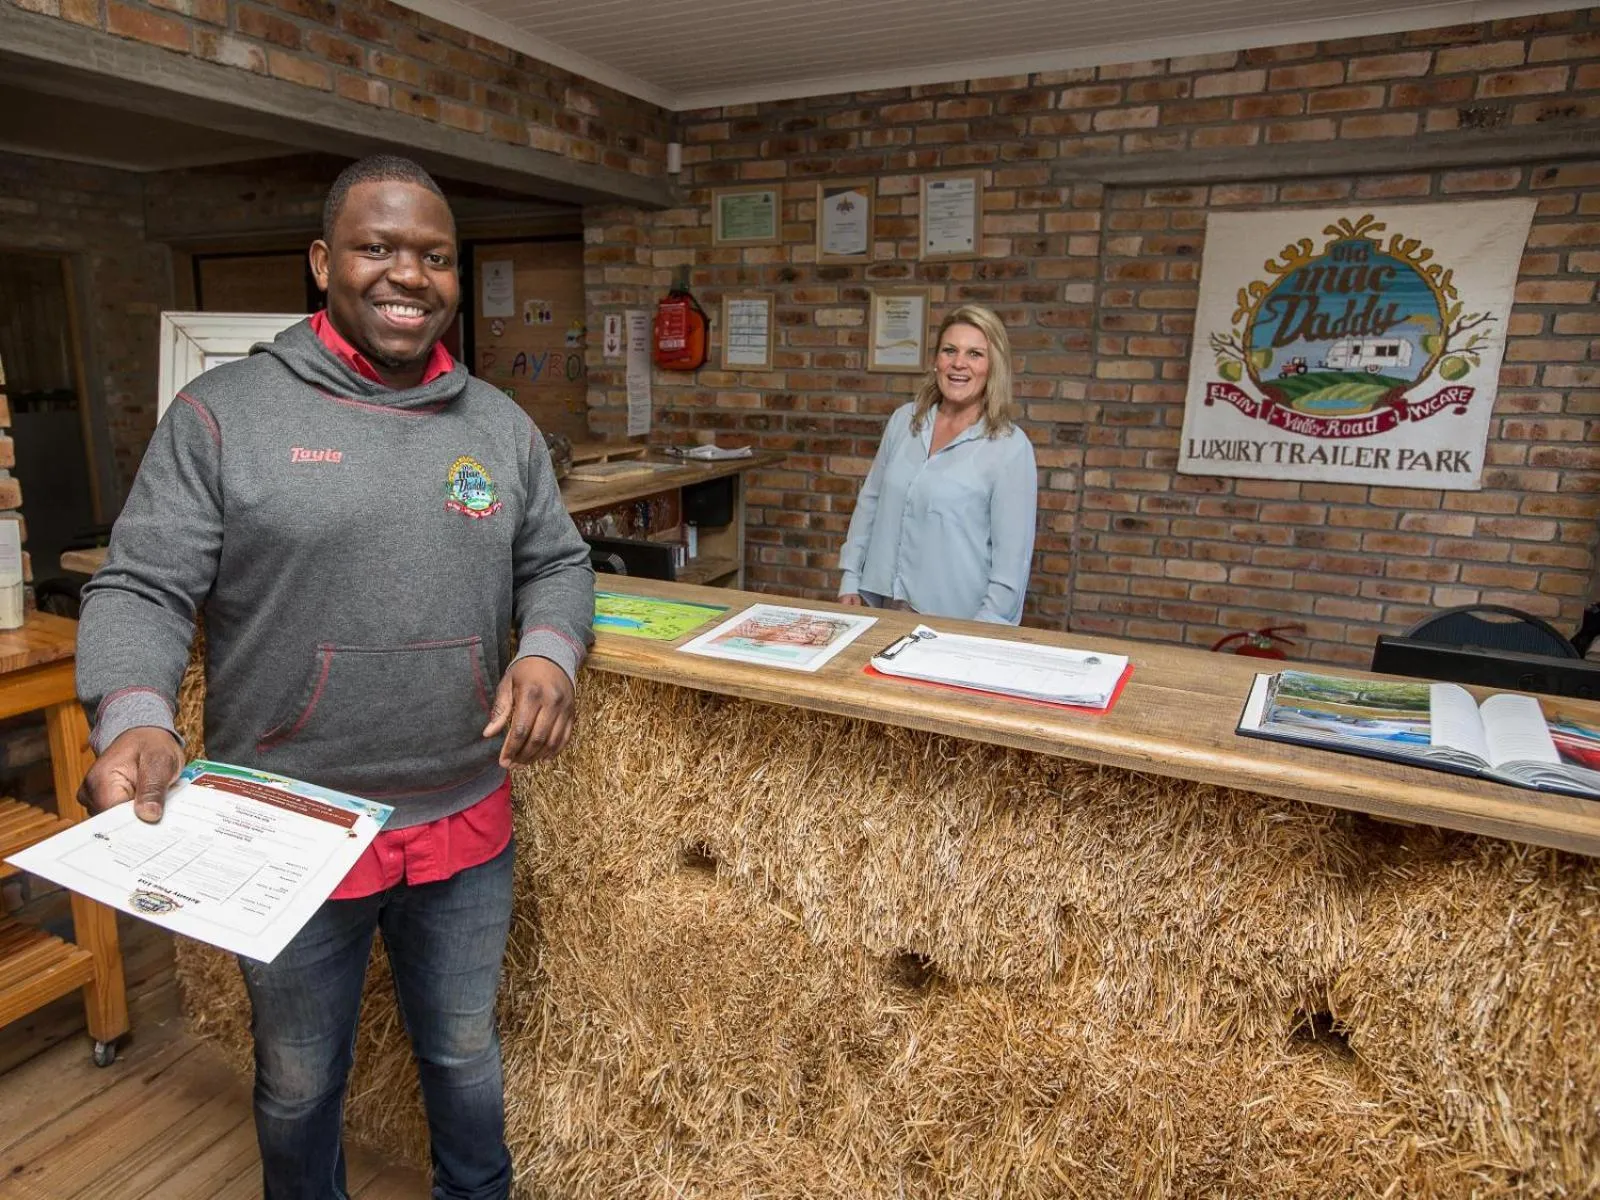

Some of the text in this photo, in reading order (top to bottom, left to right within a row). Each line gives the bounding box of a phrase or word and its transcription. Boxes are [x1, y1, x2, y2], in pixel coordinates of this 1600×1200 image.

[1251, 294, 1411, 348] Daddy
[1210, 384, 1256, 413] ELGIN
[1322, 416, 1379, 437] Road
[1187, 438, 1473, 473] LUXURY TRAILER PARK
